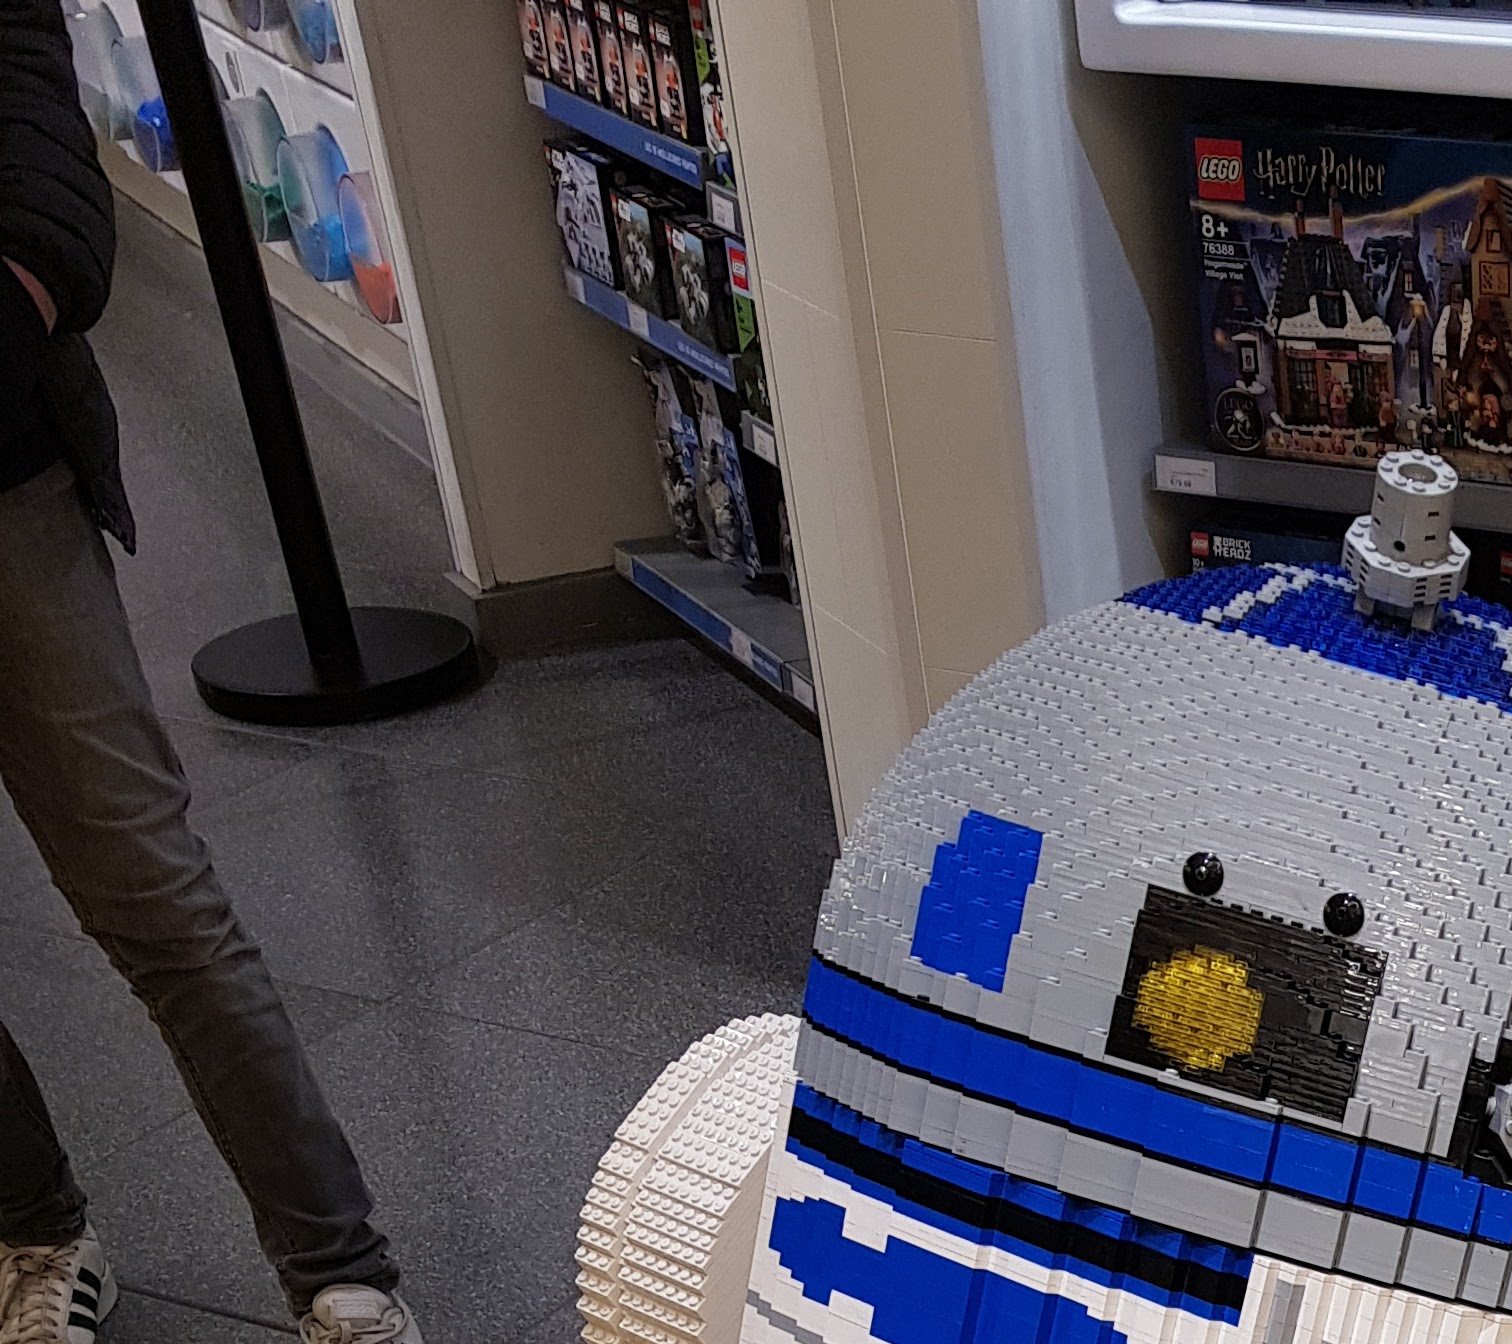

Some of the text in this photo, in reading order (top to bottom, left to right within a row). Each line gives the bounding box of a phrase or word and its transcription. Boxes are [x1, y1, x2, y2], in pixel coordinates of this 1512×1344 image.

[1200, 156, 1241, 181] LEGO
[1253, 146, 1385, 199] Harry Potter
[1202, 215, 1228, 238] 8+
[1203, 242, 1234, 255] 76388
[1213, 545, 1252, 562] HEADZ
[1222, 537, 1251, 551] BRICK
